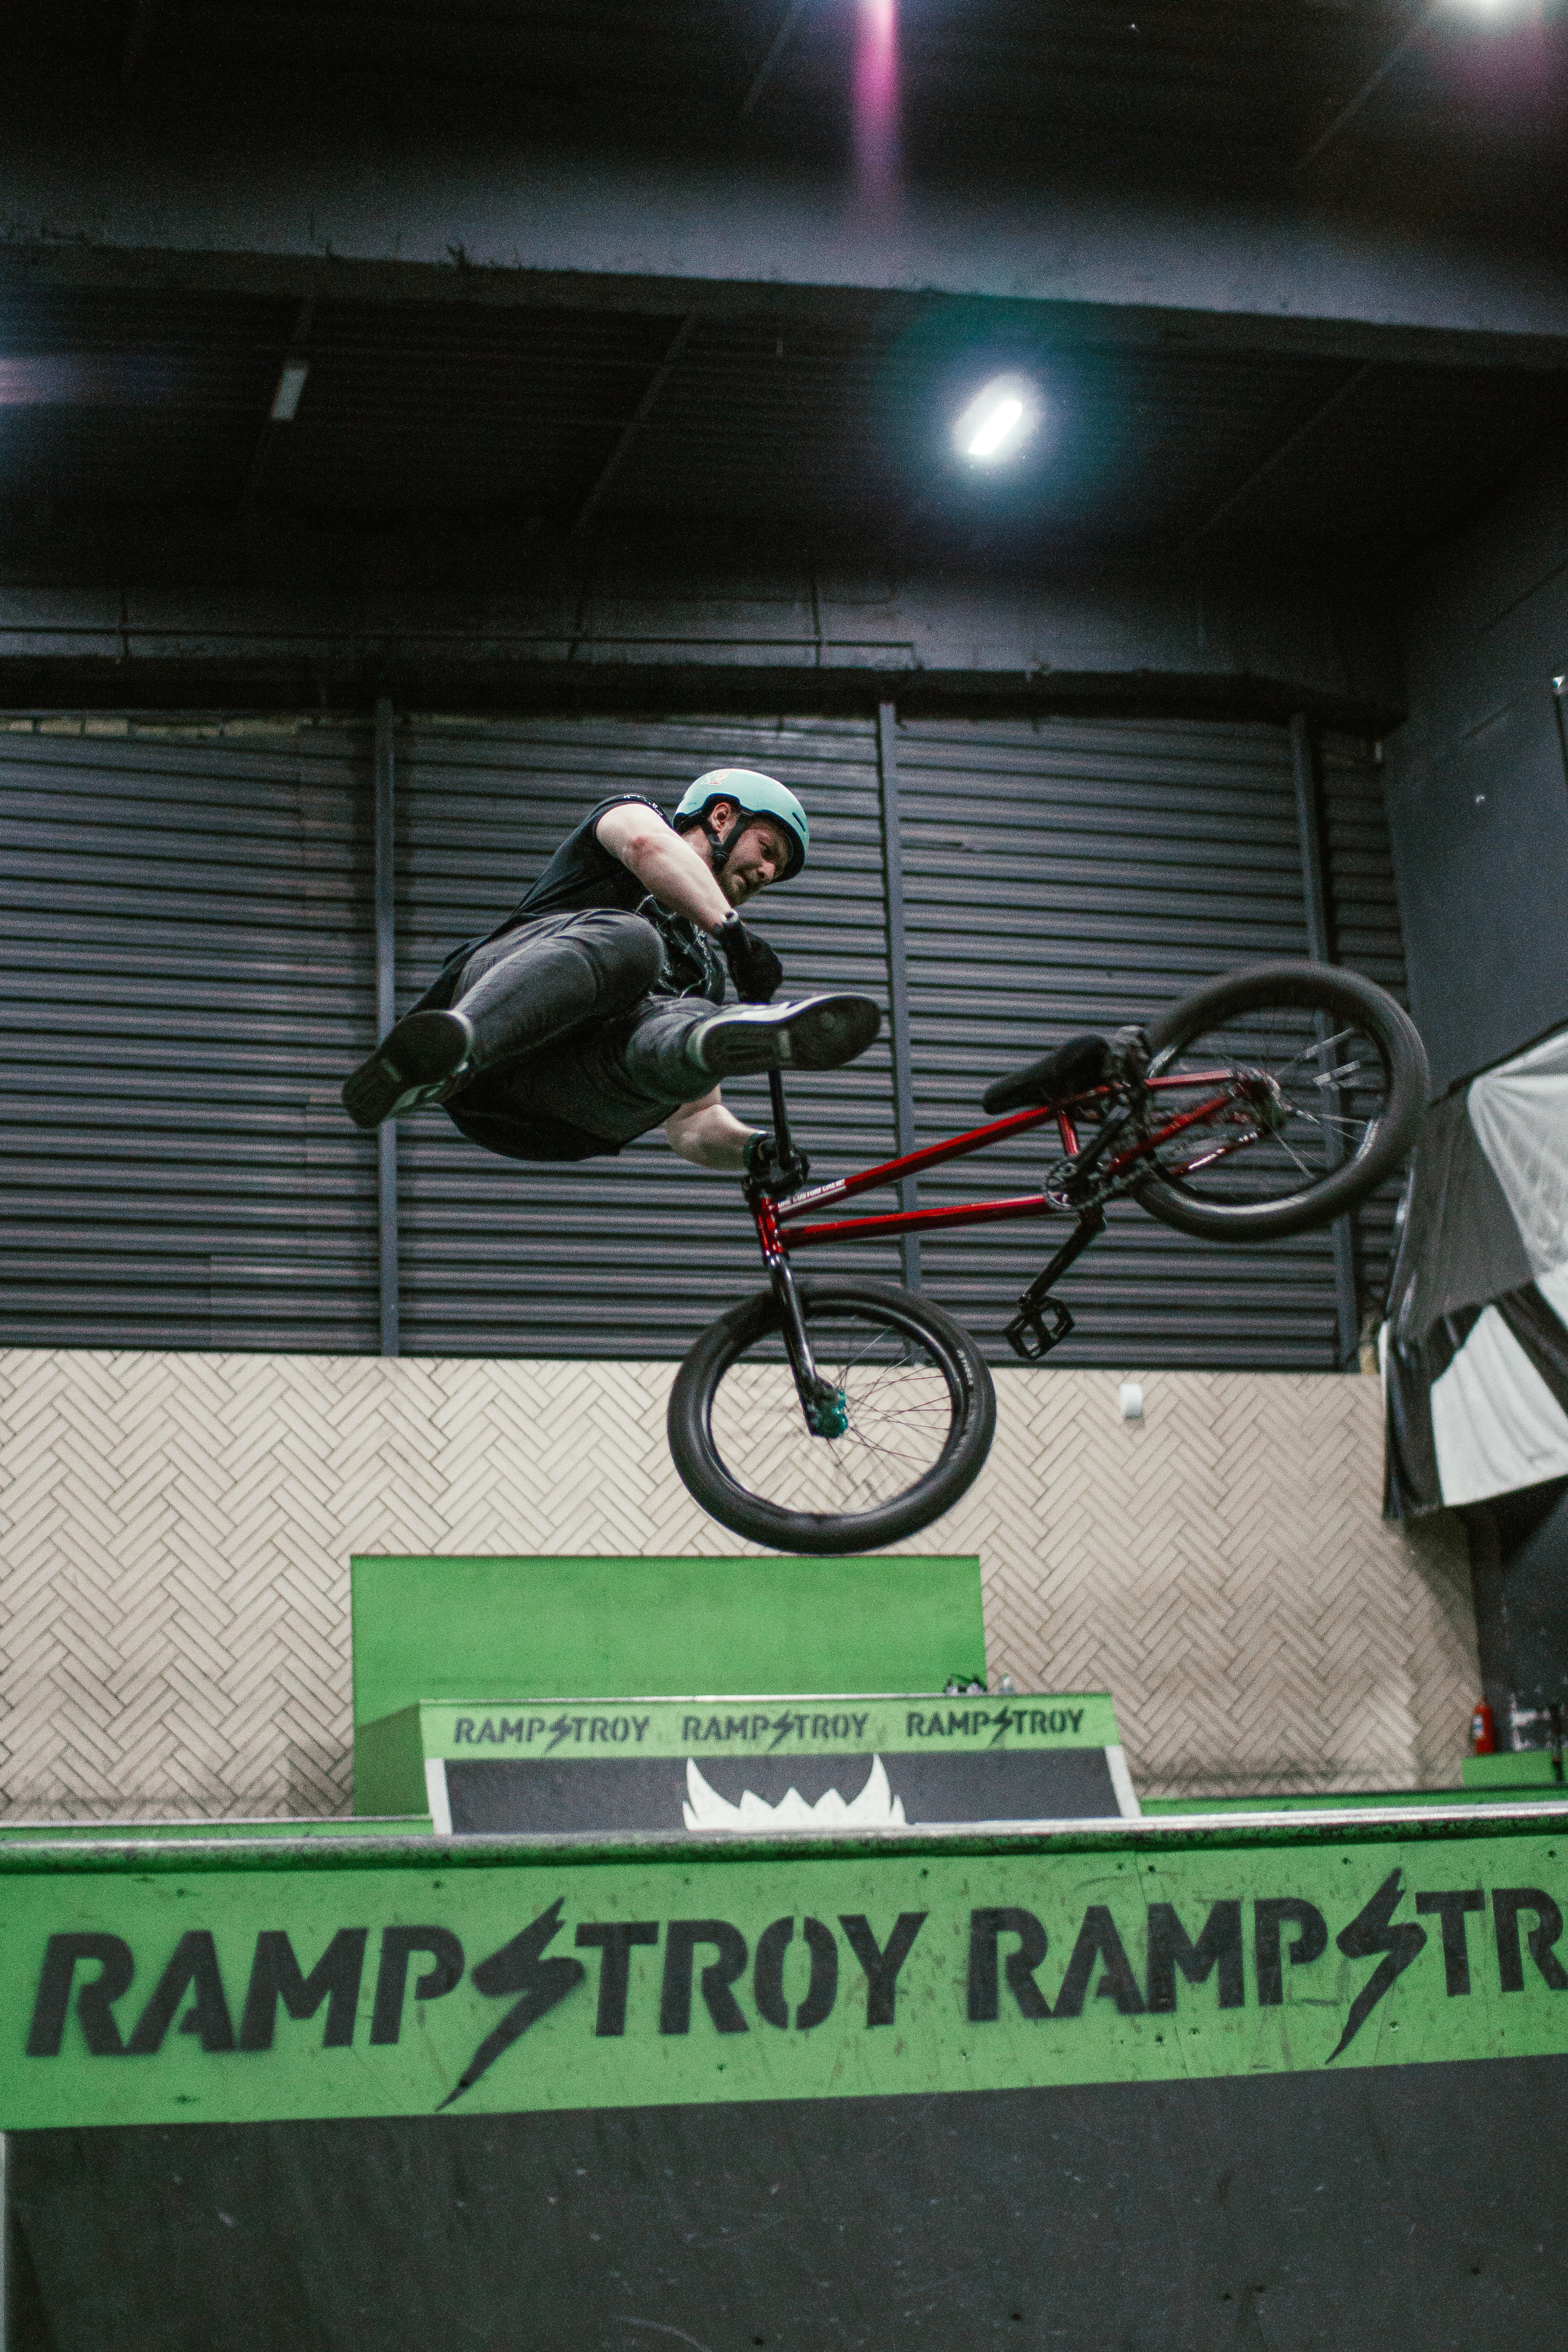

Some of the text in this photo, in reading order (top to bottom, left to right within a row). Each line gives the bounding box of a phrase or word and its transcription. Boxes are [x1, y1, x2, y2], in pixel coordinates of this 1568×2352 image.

[453, 1705, 1085, 1754] RAMPSTROY RAMPSTROY RAMPSTROY
[25, 1867, 1568, 2113] RAMPSTROY RAMPSTR
